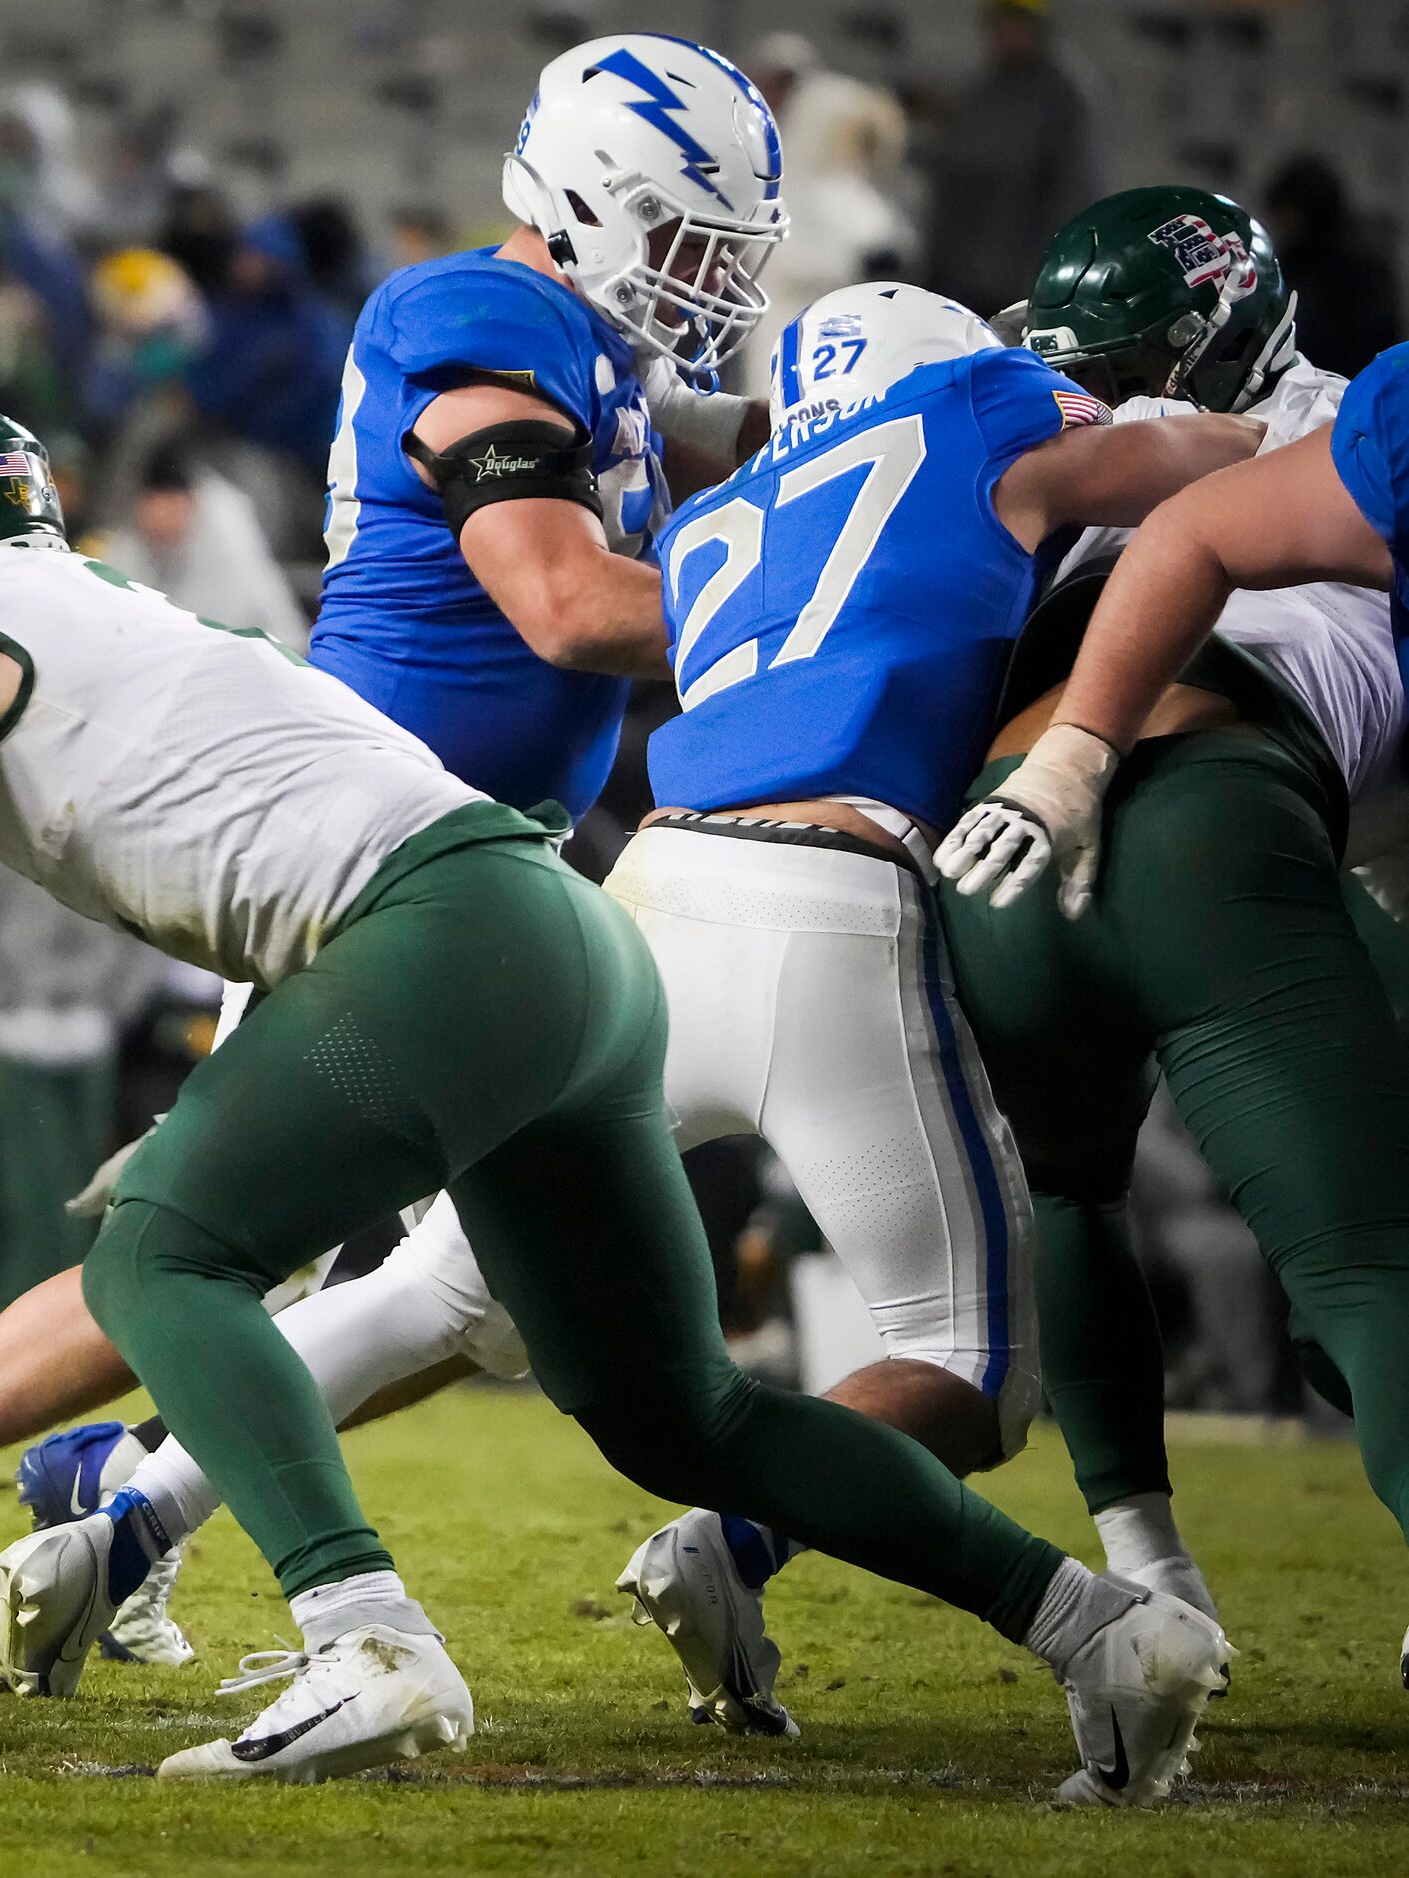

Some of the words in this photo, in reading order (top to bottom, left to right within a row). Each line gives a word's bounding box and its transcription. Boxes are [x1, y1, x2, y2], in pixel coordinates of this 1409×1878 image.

[812, 338, 868, 381] 27
[485, 456, 535, 472] Douglas
[667, 413, 928, 714] 27
